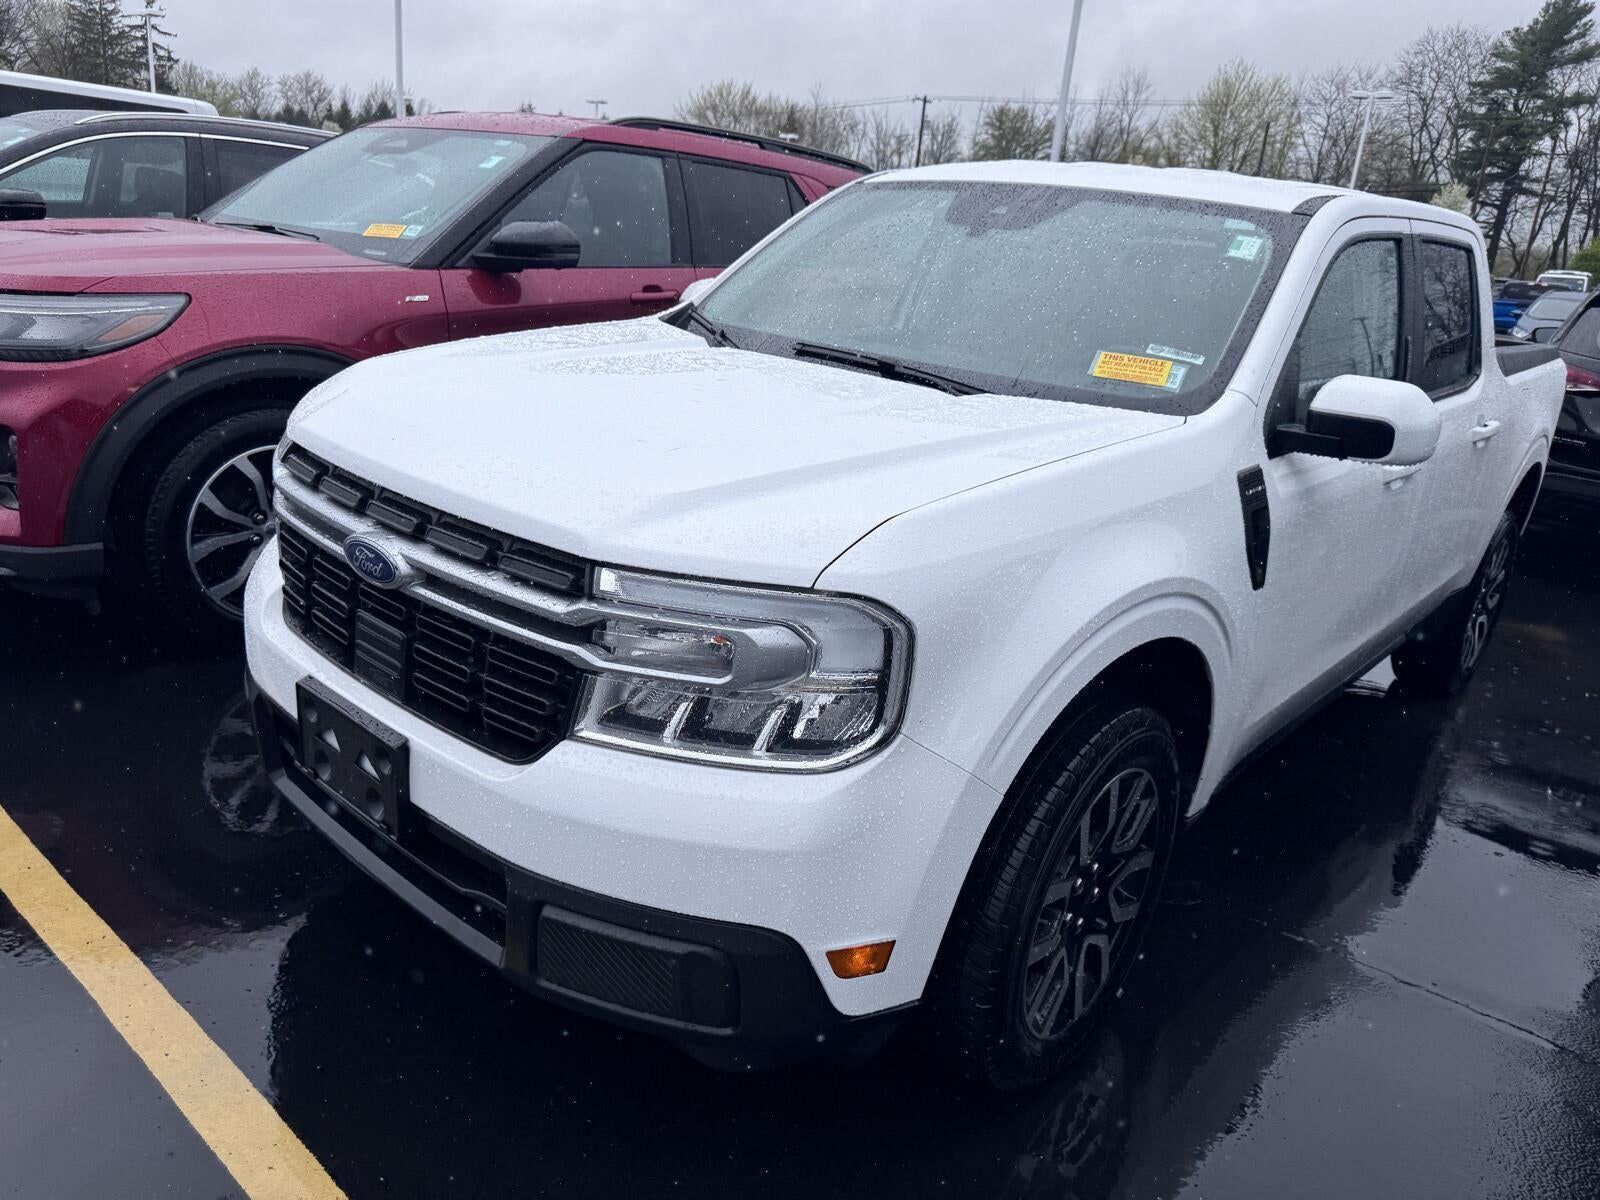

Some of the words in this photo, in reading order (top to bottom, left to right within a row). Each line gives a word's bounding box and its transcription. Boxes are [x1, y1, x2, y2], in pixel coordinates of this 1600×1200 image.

[1104, 353, 1125, 362] THIS
[1127, 355, 1166, 367] VEHICLE
[1113, 361, 1134, 369] READY
[1134, 363, 1148, 371] FOR
[1148, 364, 1164, 373] SALE
[354, 546, 383, 577] Ford
